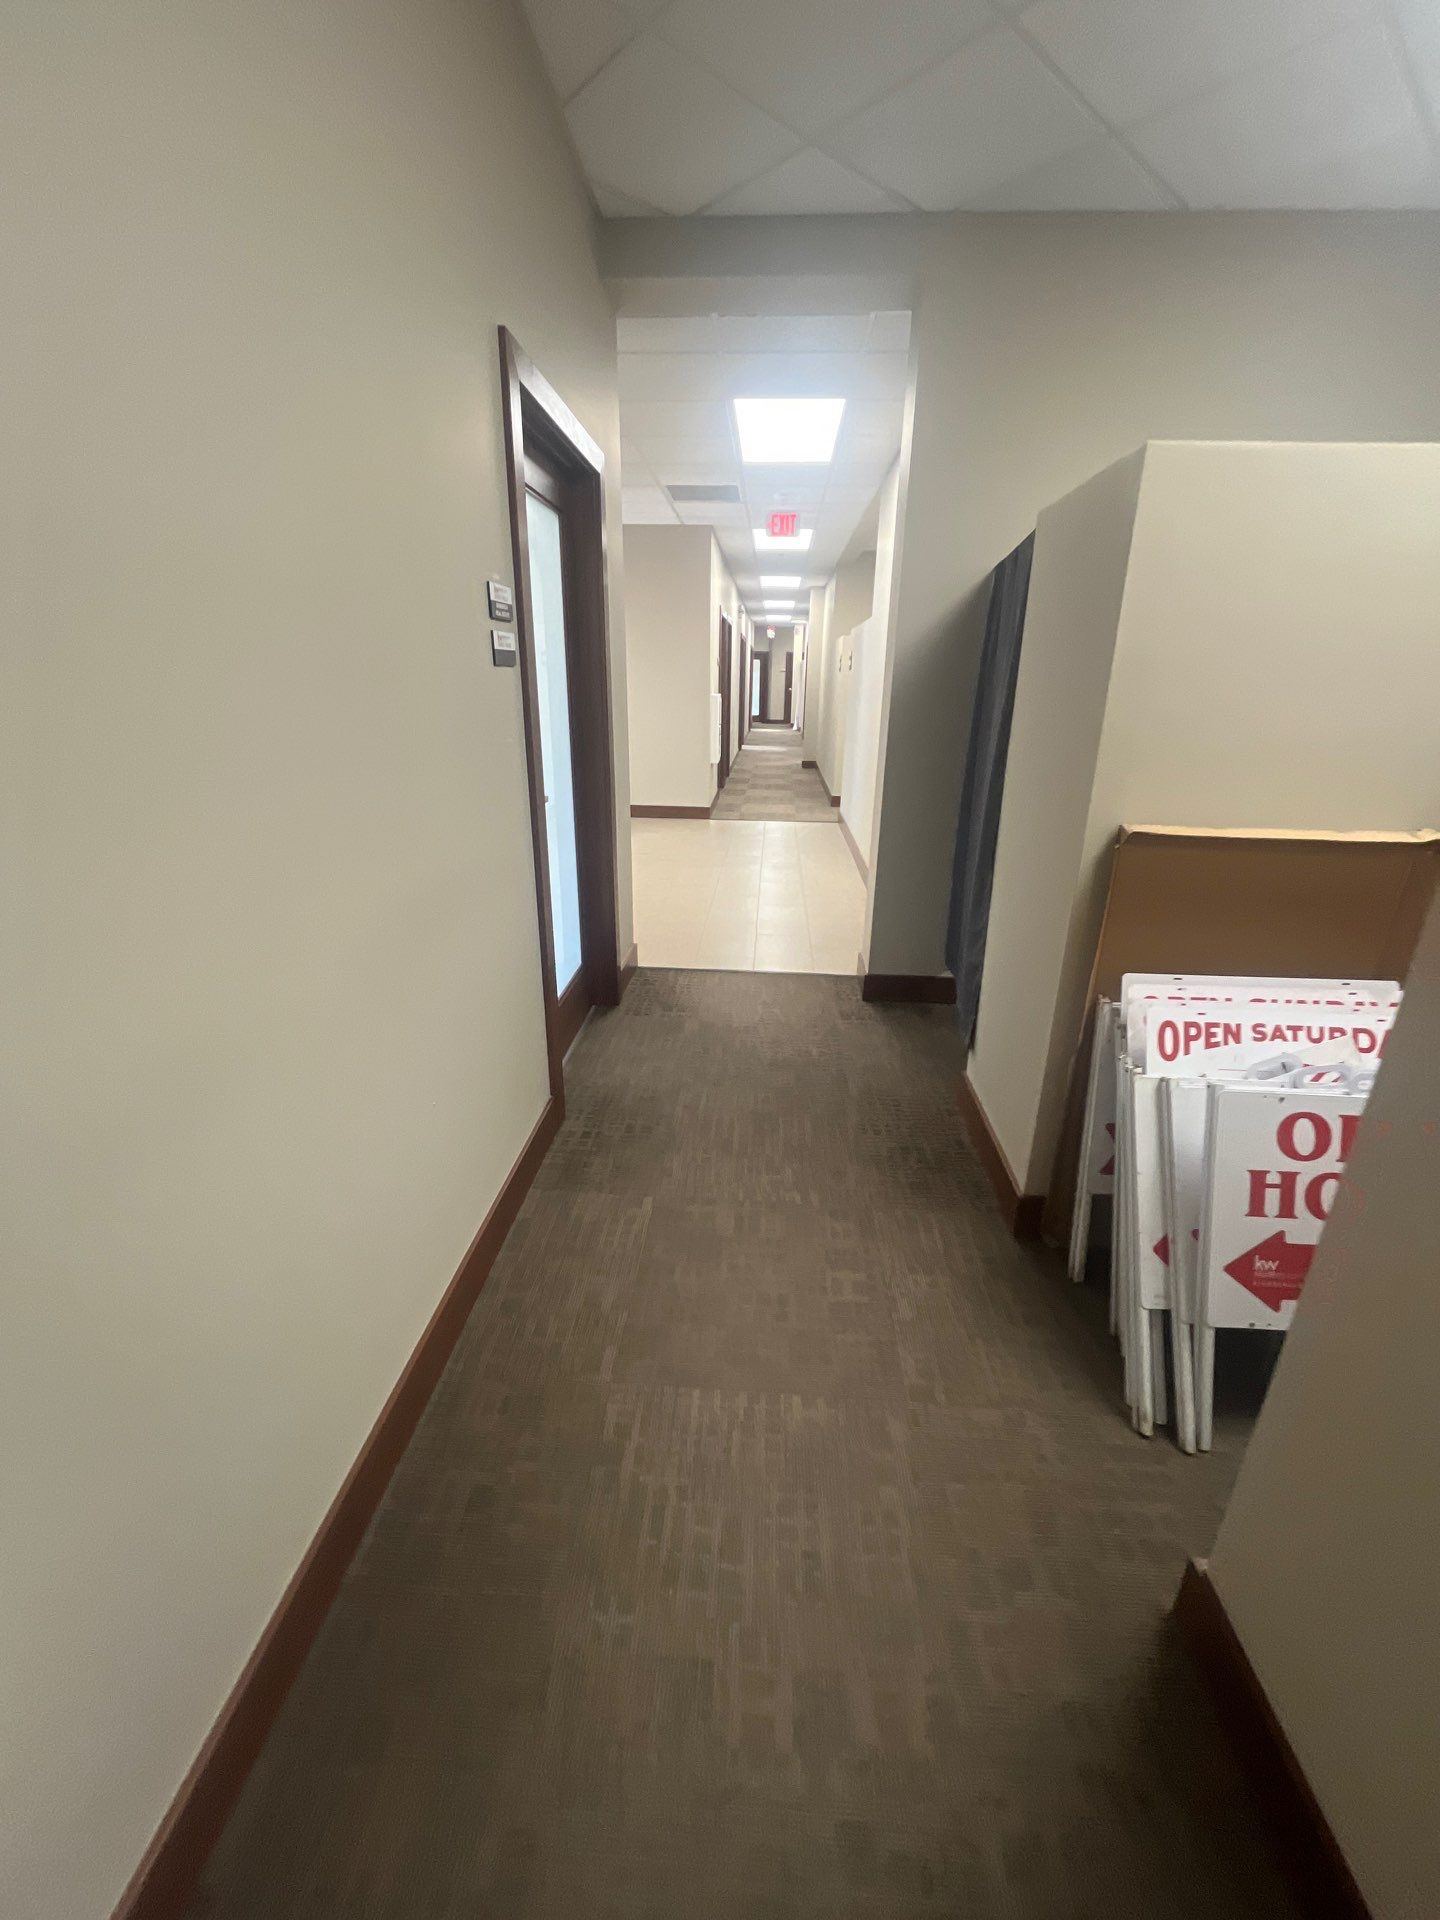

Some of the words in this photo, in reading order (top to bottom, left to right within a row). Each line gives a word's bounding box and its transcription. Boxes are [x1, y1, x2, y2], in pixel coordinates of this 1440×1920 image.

[771, 512, 797, 536] EXIT
[1157, 1019, 1242, 1062] OPEN
[1254, 1254, 1280, 1271] kw
